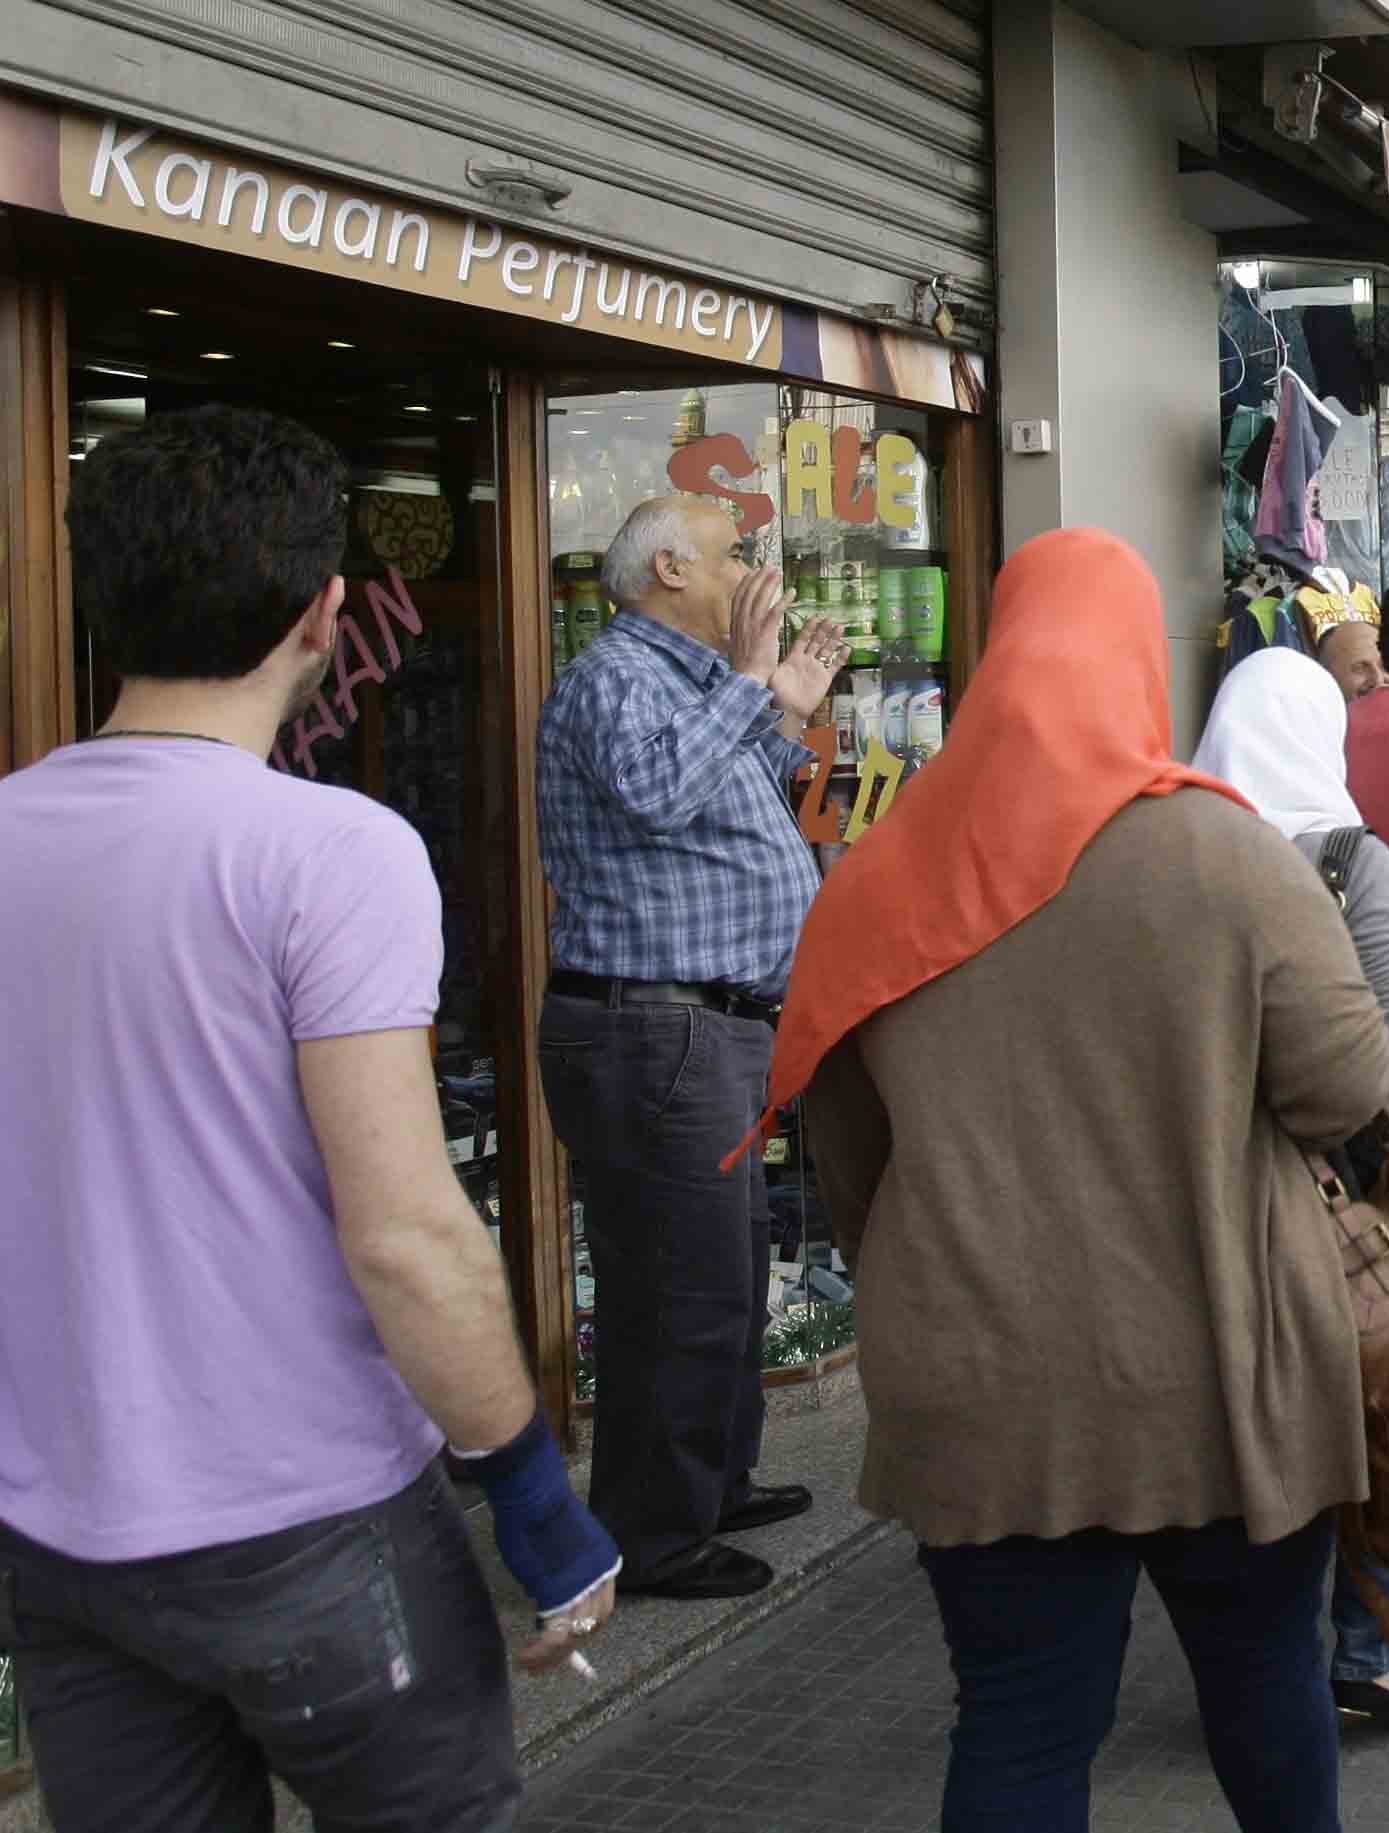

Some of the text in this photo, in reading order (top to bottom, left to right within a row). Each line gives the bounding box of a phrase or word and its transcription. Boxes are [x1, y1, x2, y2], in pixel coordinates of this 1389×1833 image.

[89, 119, 776, 361] Kanaan Perfumery
[667, 418, 917, 535] SALE
